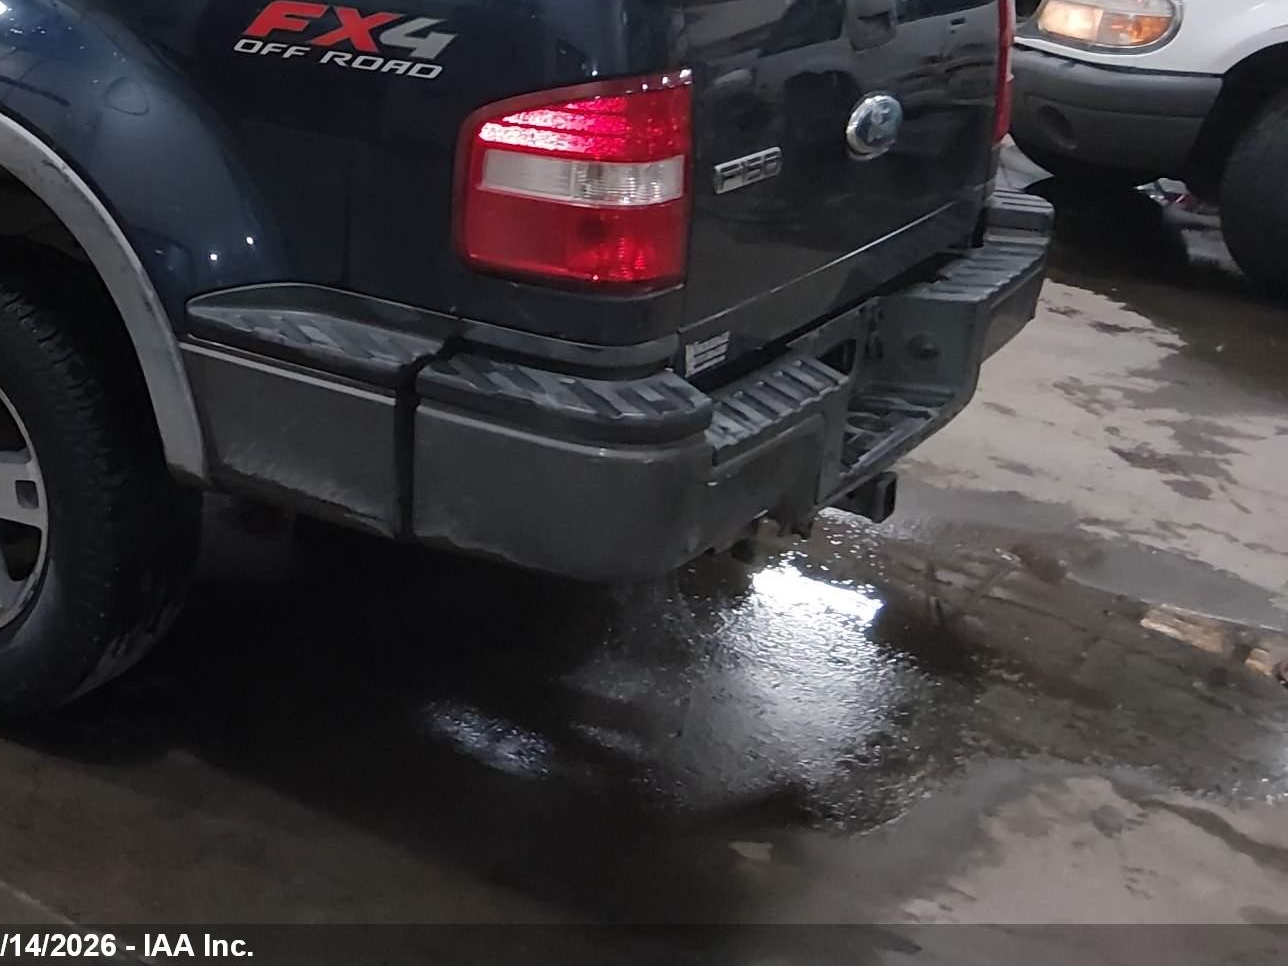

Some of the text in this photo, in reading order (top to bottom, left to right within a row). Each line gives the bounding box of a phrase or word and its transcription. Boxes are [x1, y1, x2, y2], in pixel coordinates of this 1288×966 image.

[242, 0, 459, 61] FX4
[233, 38, 444, 80] OFF ROAD
